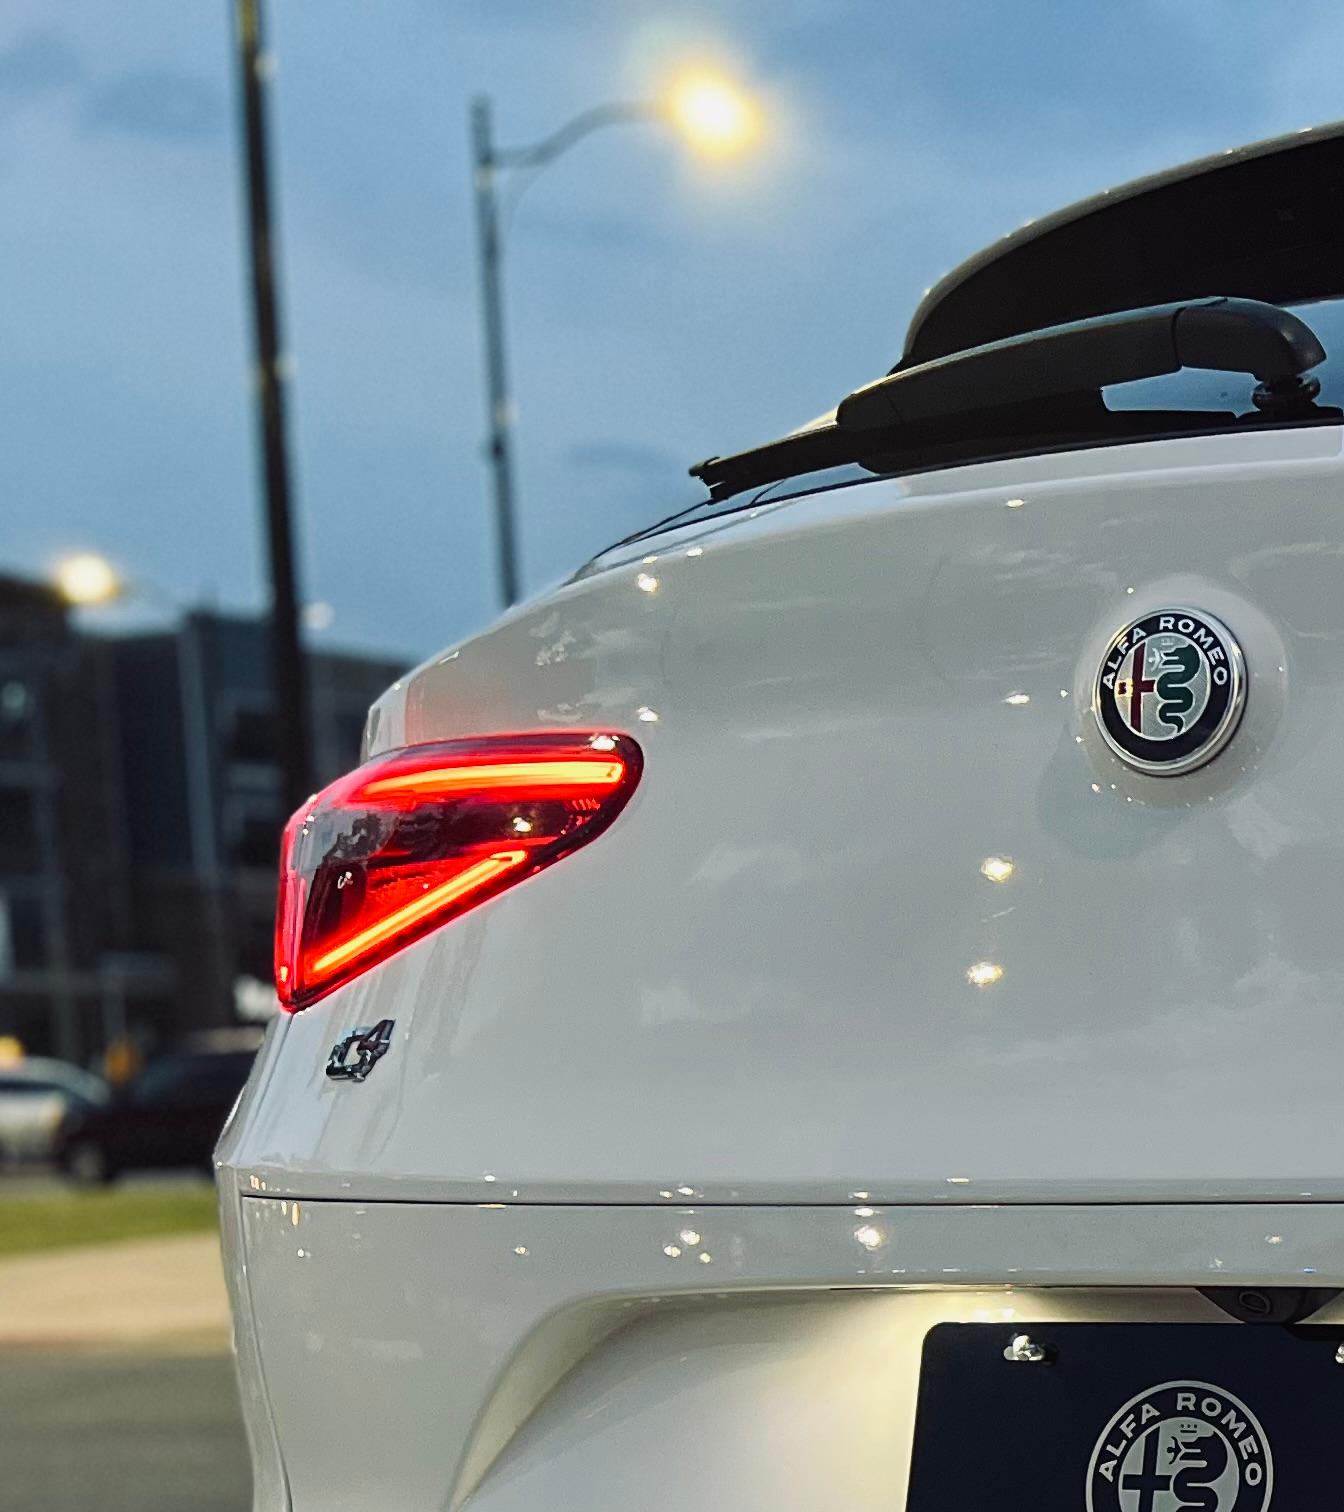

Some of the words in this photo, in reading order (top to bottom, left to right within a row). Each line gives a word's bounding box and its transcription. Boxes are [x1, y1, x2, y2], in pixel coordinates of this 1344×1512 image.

[1103, 627, 1147, 690] ALFA
[1159, 616, 1228, 685] ROMEO
[1099, 1403, 1160, 1482] ALFA
[1176, 1393, 1262, 1486] ROMEO
